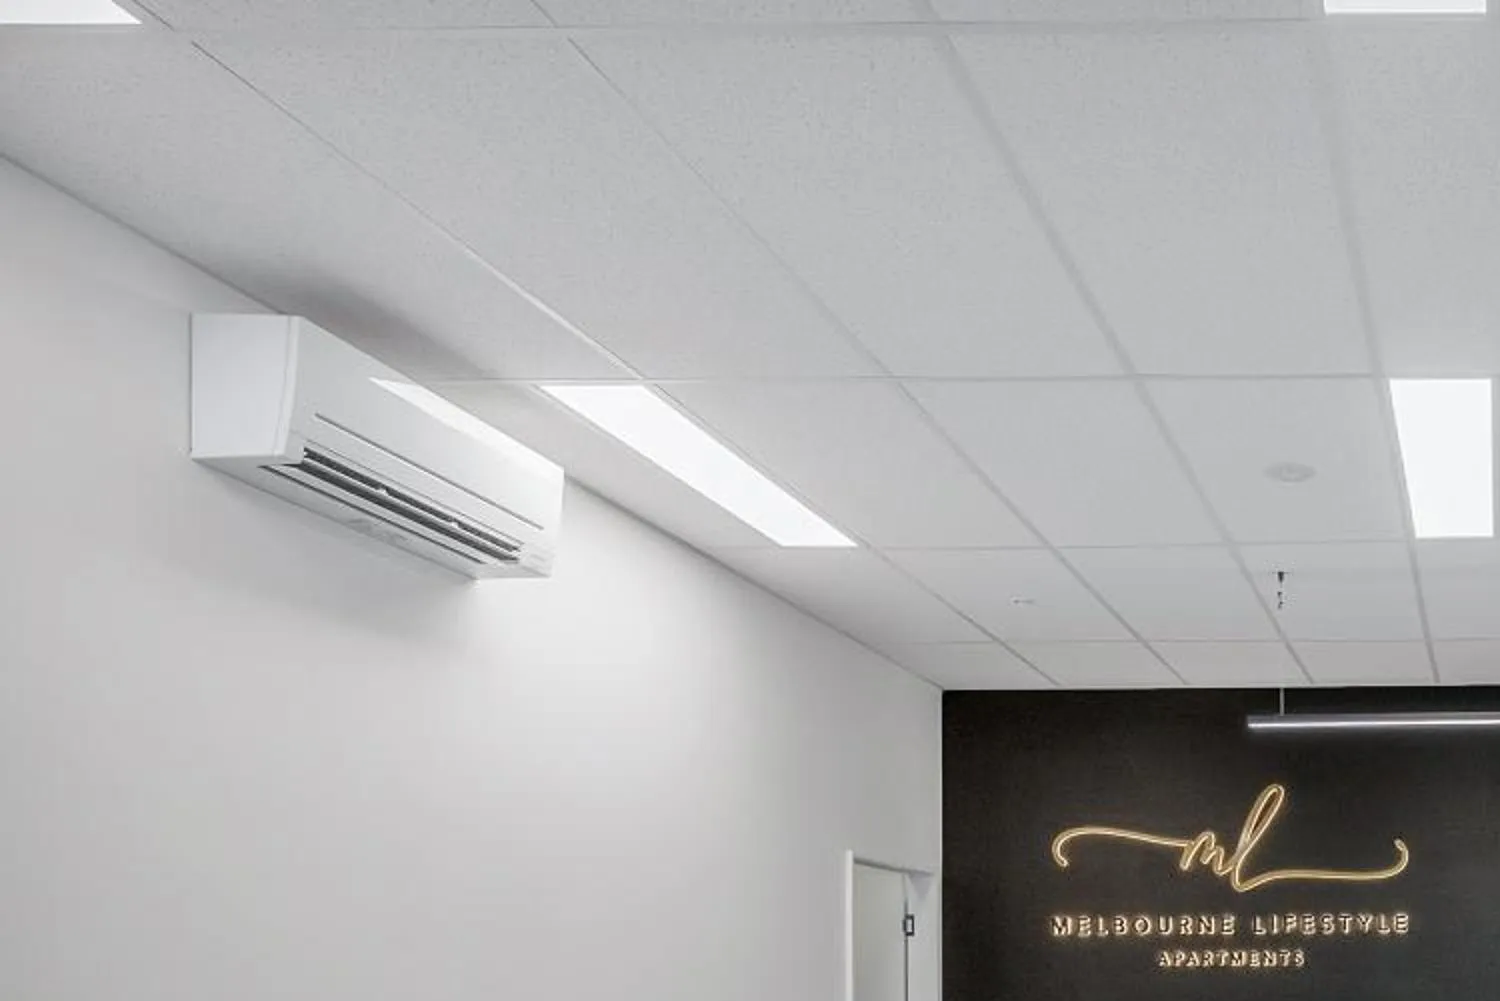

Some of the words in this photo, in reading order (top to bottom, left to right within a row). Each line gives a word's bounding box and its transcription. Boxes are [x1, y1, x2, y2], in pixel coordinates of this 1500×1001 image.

[1050, 914, 1236, 937] MELBOURNE
[1252, 913, 1410, 935] LIFESTYLE
[1158, 949, 1306, 967] APARTMENTS
